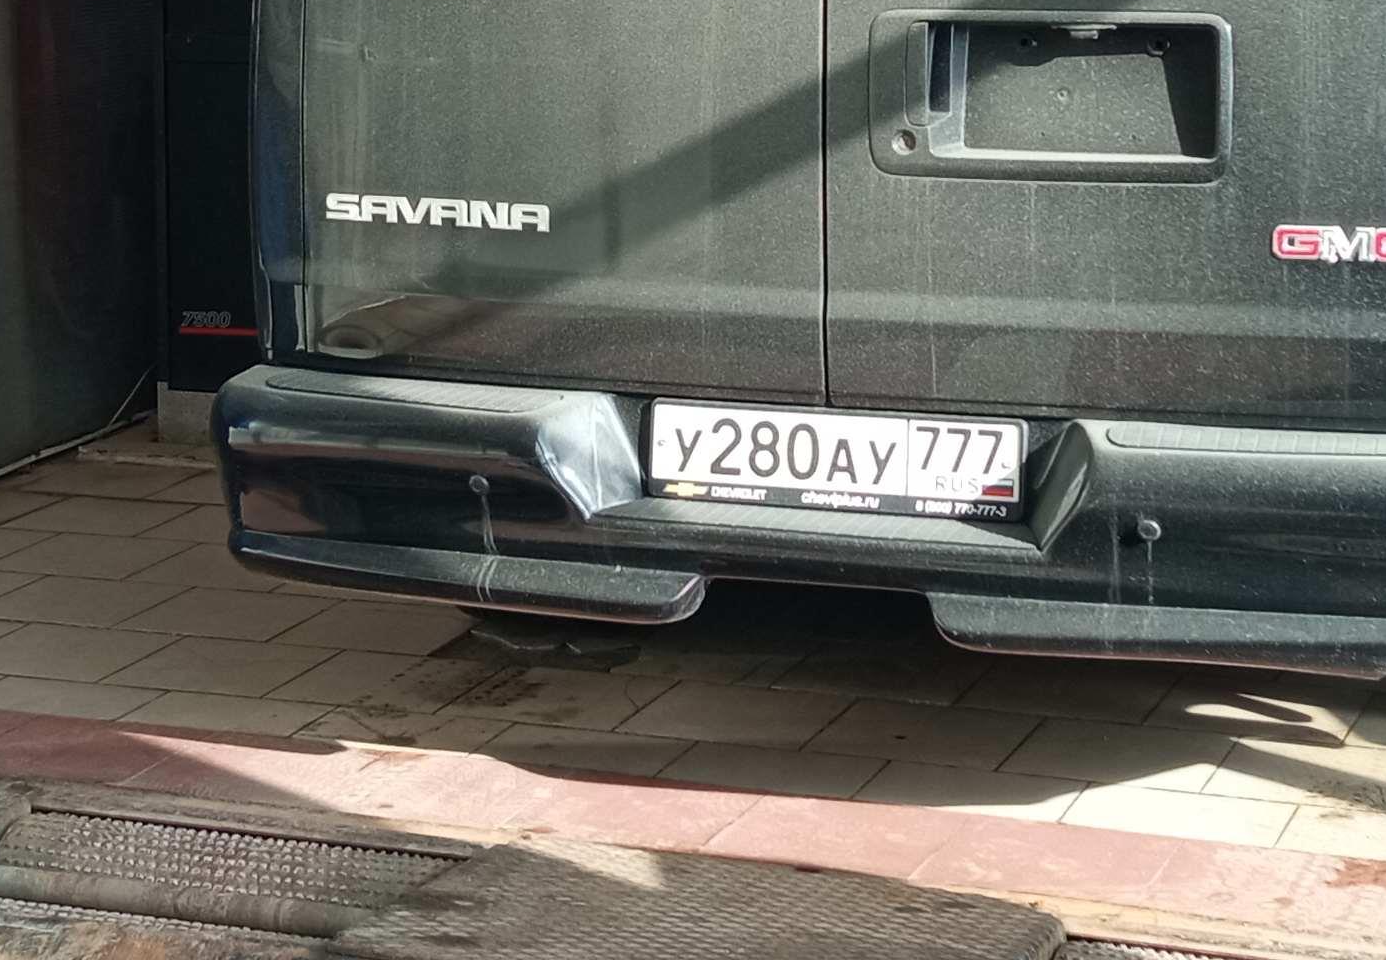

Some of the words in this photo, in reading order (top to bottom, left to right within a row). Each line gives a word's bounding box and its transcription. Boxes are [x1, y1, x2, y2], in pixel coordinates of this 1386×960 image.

[325, 192, 551, 233] SAVANA
[915, 426, 1004, 474] 777
[934, 475, 980, 496] RUS
